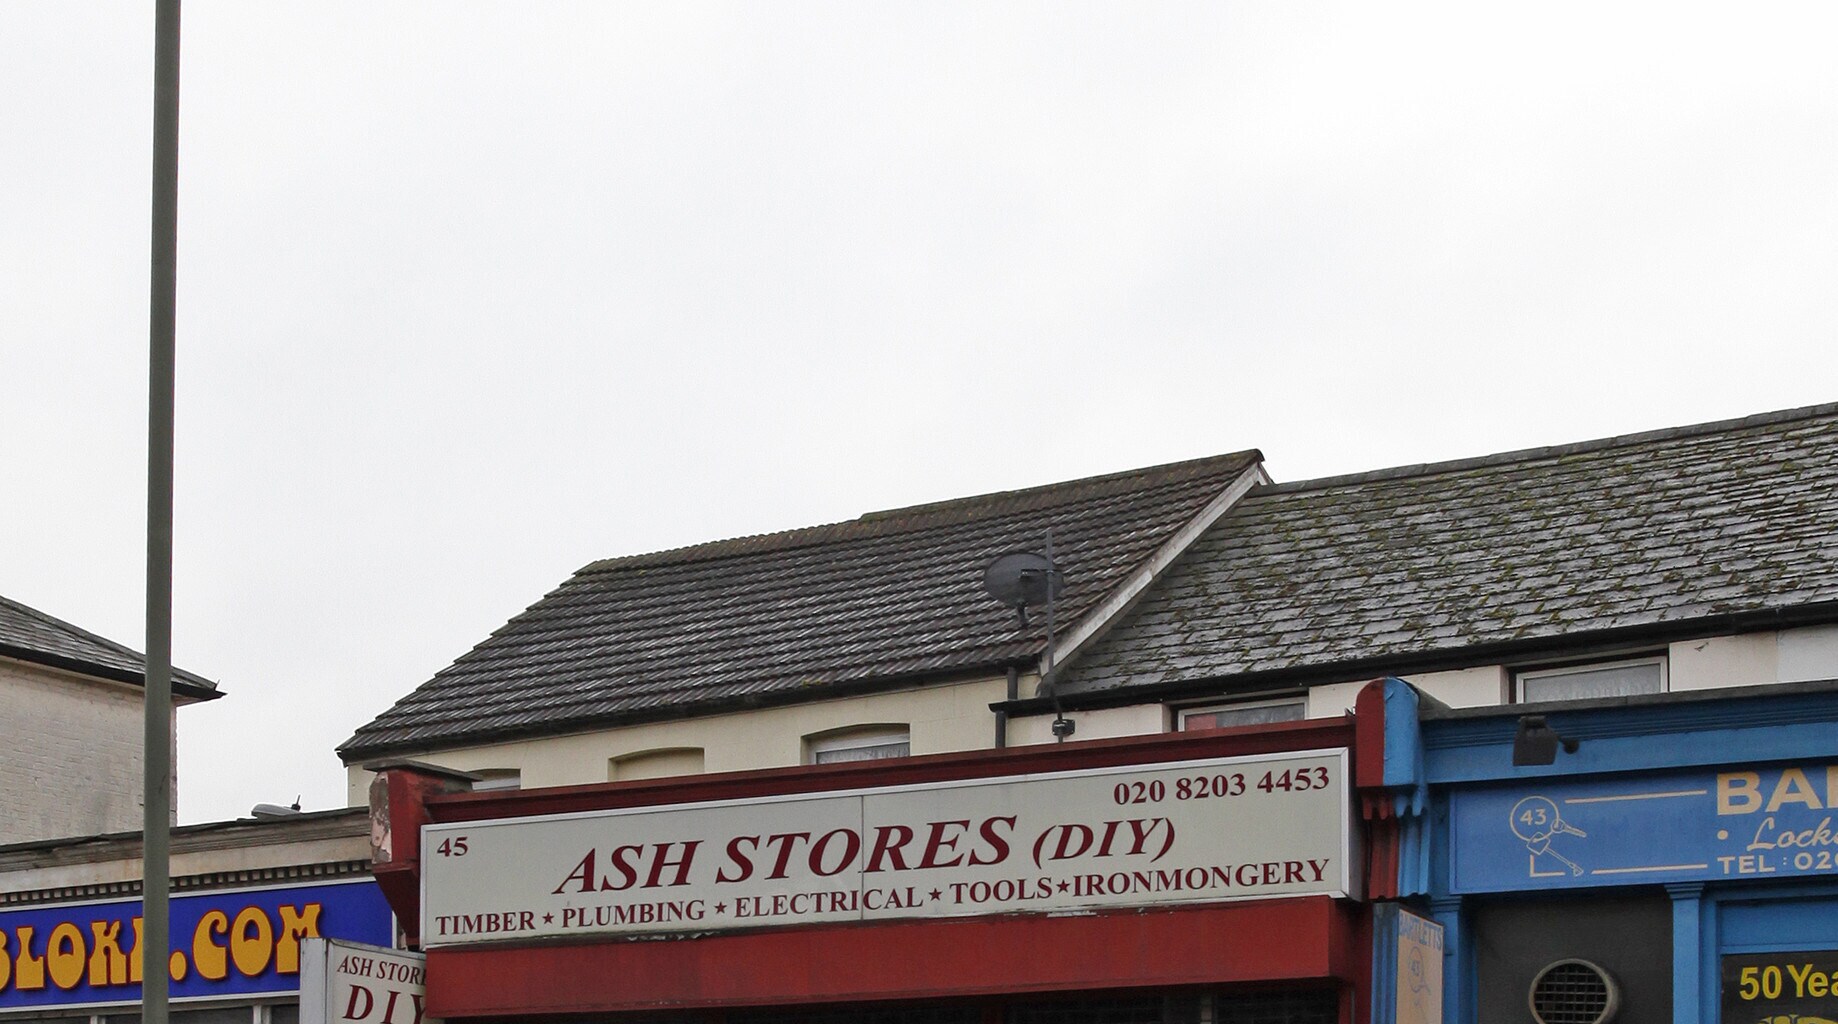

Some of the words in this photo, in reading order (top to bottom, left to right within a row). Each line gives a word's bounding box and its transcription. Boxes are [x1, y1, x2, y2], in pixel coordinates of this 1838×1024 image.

[1113, 779, 1165, 806] 020
[1176, 773, 1246, 802] 8203
[1257, 766, 1331, 793] 4453
[1520, 809, 1547, 826] 43
[436, 836, 469, 857] 45
[552, 840, 704, 896] ASH
[715, 815, 1018, 885] STORES
[1032, 817, 1176, 870] (DIY)
[1794, 851, 1838, 870] 02
[435, 911, 536, 937] TIMBER
[562, 899, 706, 929] PLUMBING
[734, 887, 924, 919] ELECTRICAL
[949, 877, 1053, 905] TOOLS
[1073, 859, 1331, 898] IRONMONGERY
[337, 955, 374, 977] ASH
[1739, 965, 1782, 1001] 50
